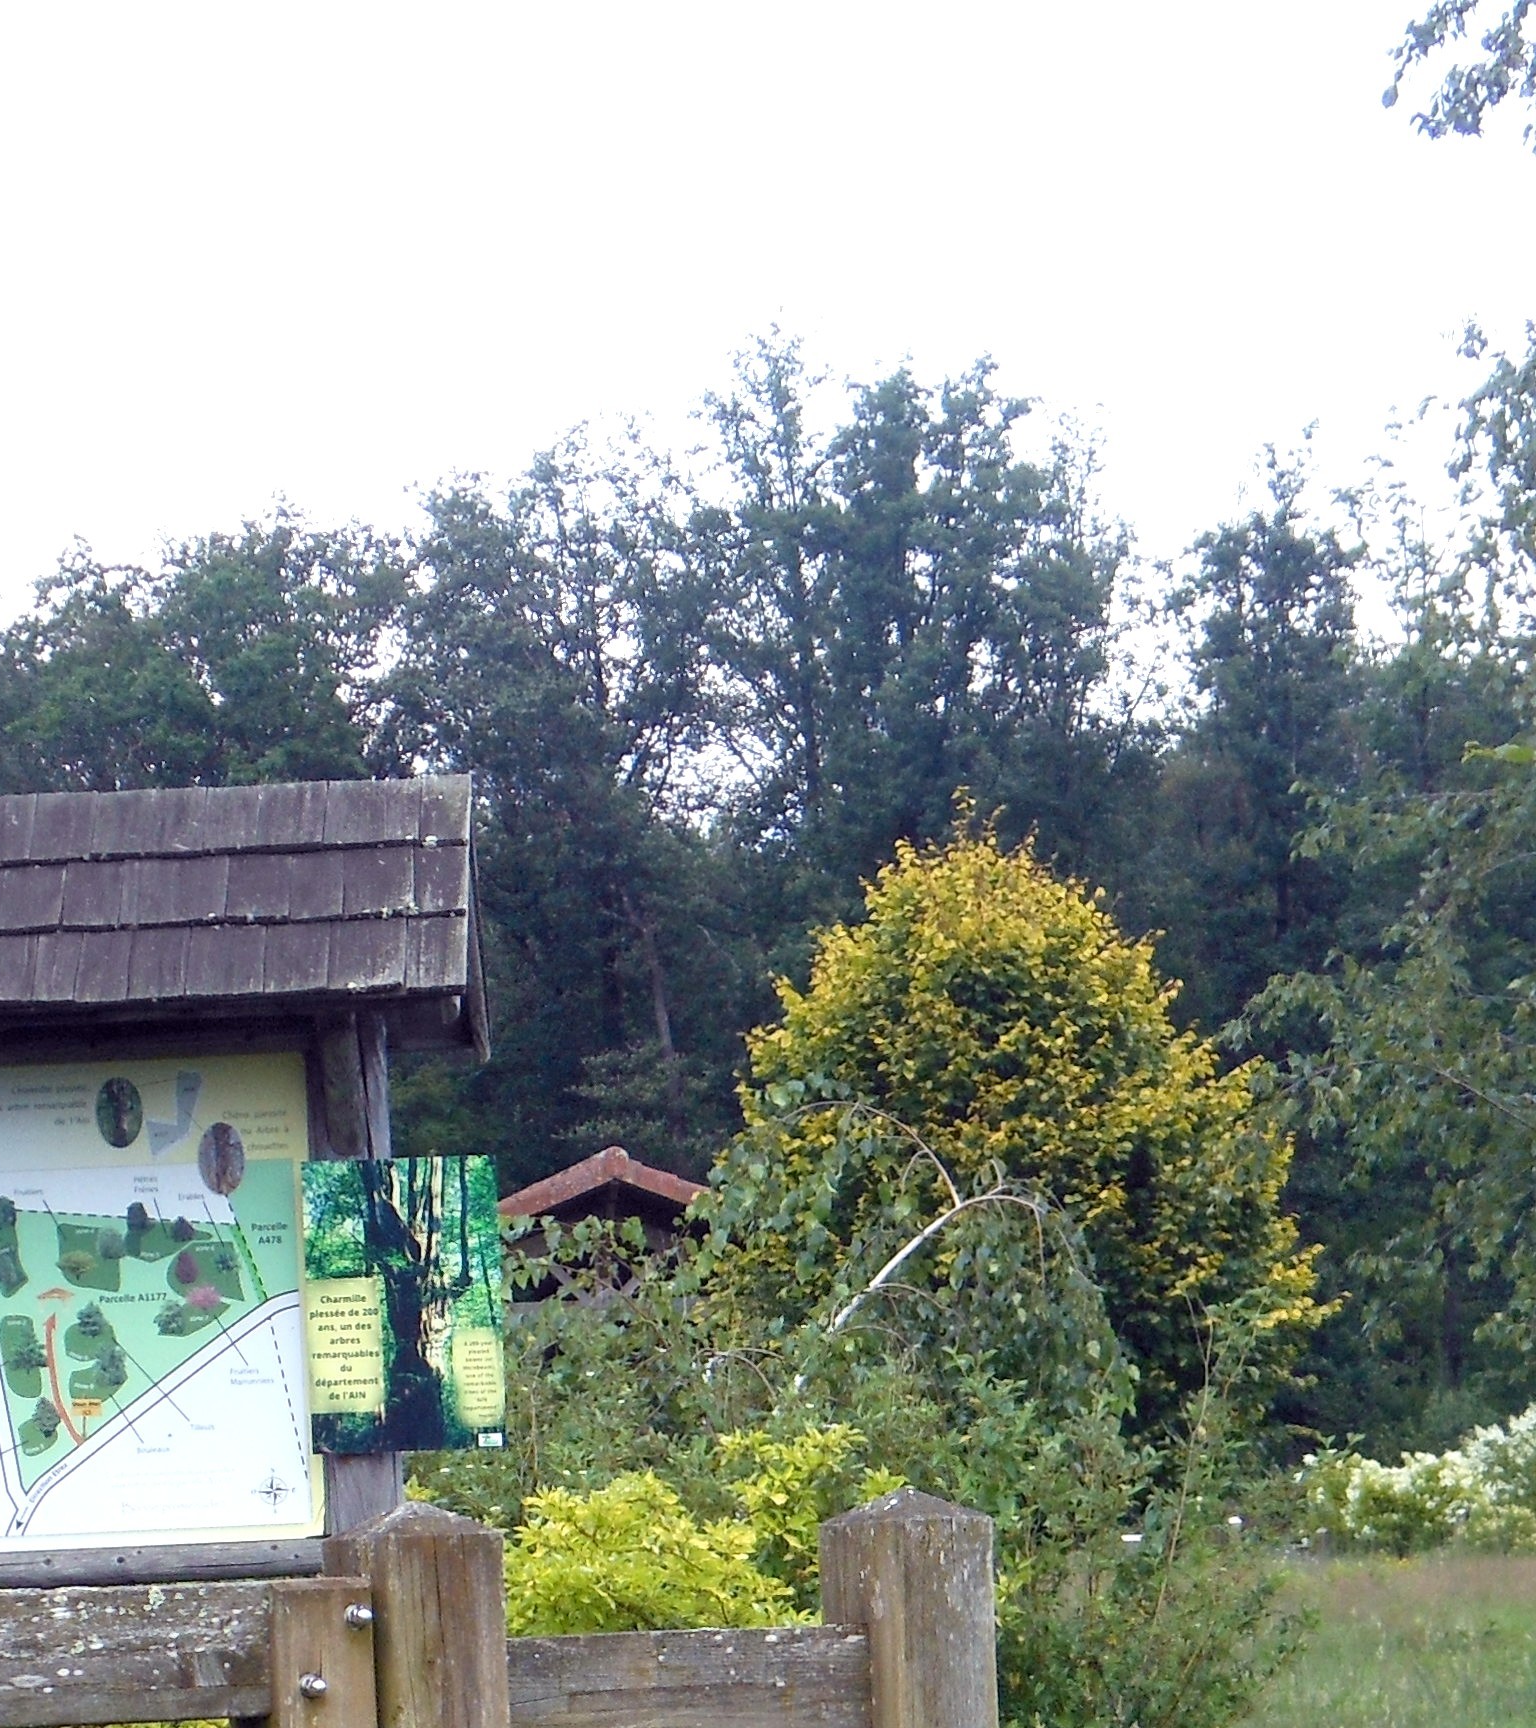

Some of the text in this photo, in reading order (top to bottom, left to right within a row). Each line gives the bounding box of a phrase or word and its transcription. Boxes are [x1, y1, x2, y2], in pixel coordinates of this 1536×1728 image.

[251, 1222, 288, 1232] Parcelle
[258, 1235, 283, 1246] A478
[99, 1292, 167, 1305] Parcelle A1177
[320, 1294, 367, 1305] Charmille
[309, 1307, 379, 1321] plessée de 200
[317, 1322, 372, 1333] ans, un des
[329, 1336, 361, 1345] arbres
[312, 1349, 380, 1361] remarquables
[340, 1364, 353, 1373] du
[315, 1377, 379, 1389] département
[328, 1391, 367, 1401] de l'AIN
